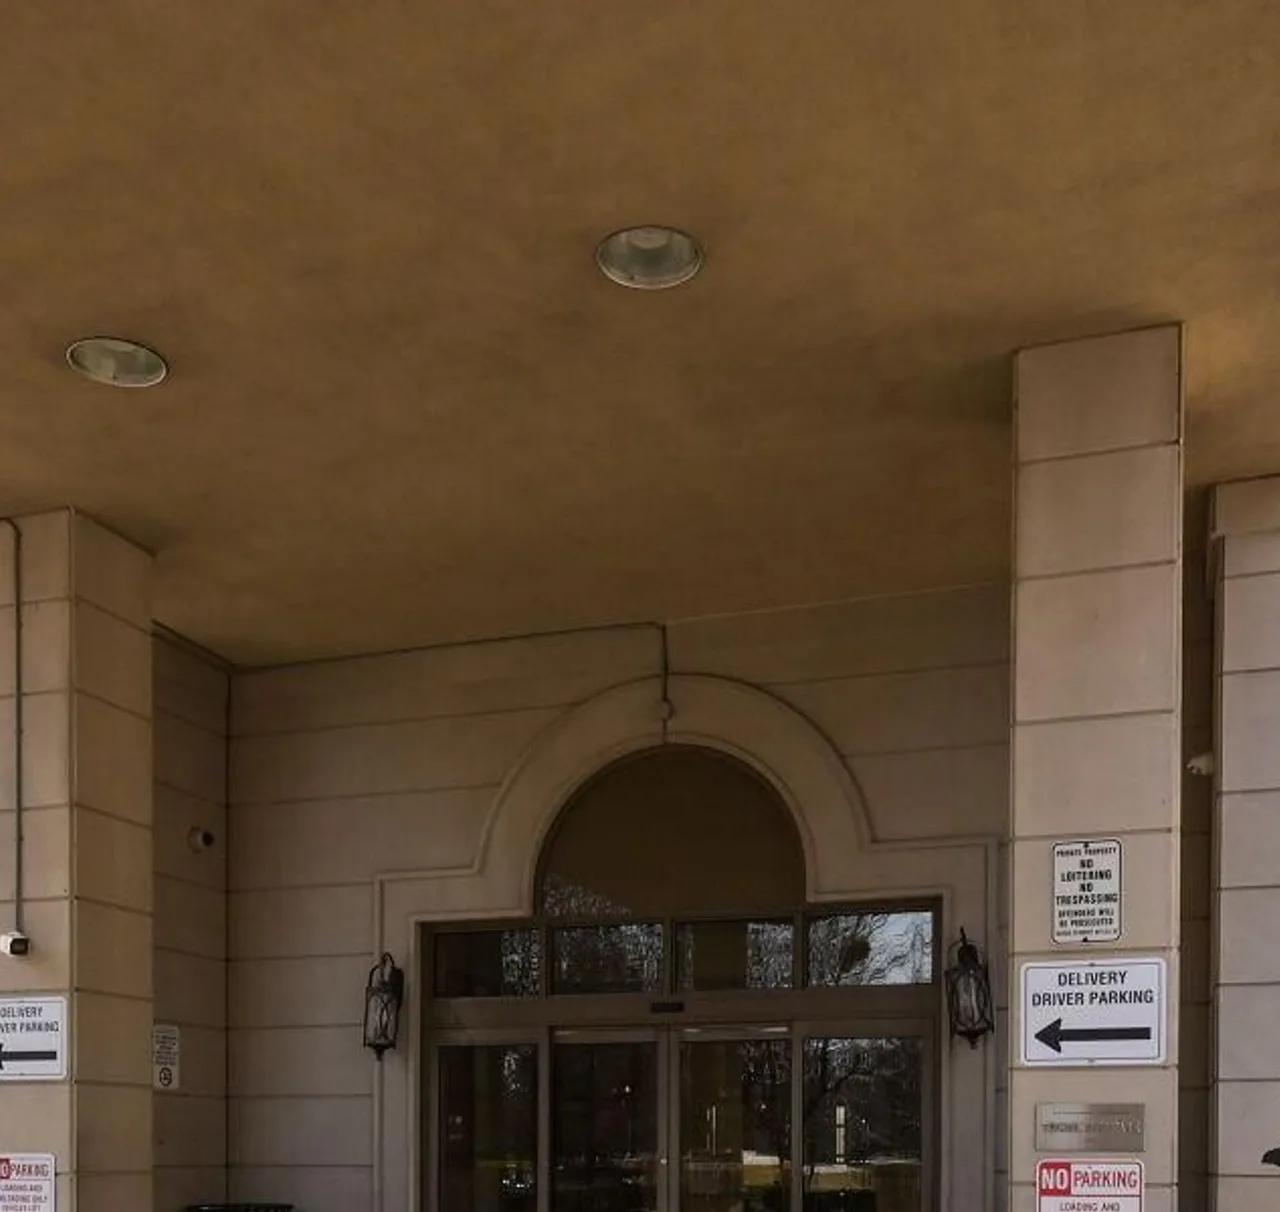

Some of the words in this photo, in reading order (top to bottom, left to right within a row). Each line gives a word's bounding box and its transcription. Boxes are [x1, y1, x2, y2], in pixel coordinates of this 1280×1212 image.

[1079, 859, 1094, 869] NO
[1060, 869, 1113, 882] LOITERING
[1079, 882, 1094, 892] NO
[1056, 893, 1118, 905] TRESPASSING
[1058, 970, 1128, 987] DELIVERY
[1032, 992, 1085, 1007] DRIVER
[1089, 990, 1154, 1005] PARKING
[0, 1006, 43, 1018] DELIVERY
[20, 1020, 59, 1032] PARKING
[10, 1163, 49, 1178] PARKING
[1041, 1168, 1069, 1190] NO
[1074, 1170, 1138, 1189] PARKING
[1059, 1202, 1098, 1212] LOADING
[1101, 1202, 1120, 1212] AND
